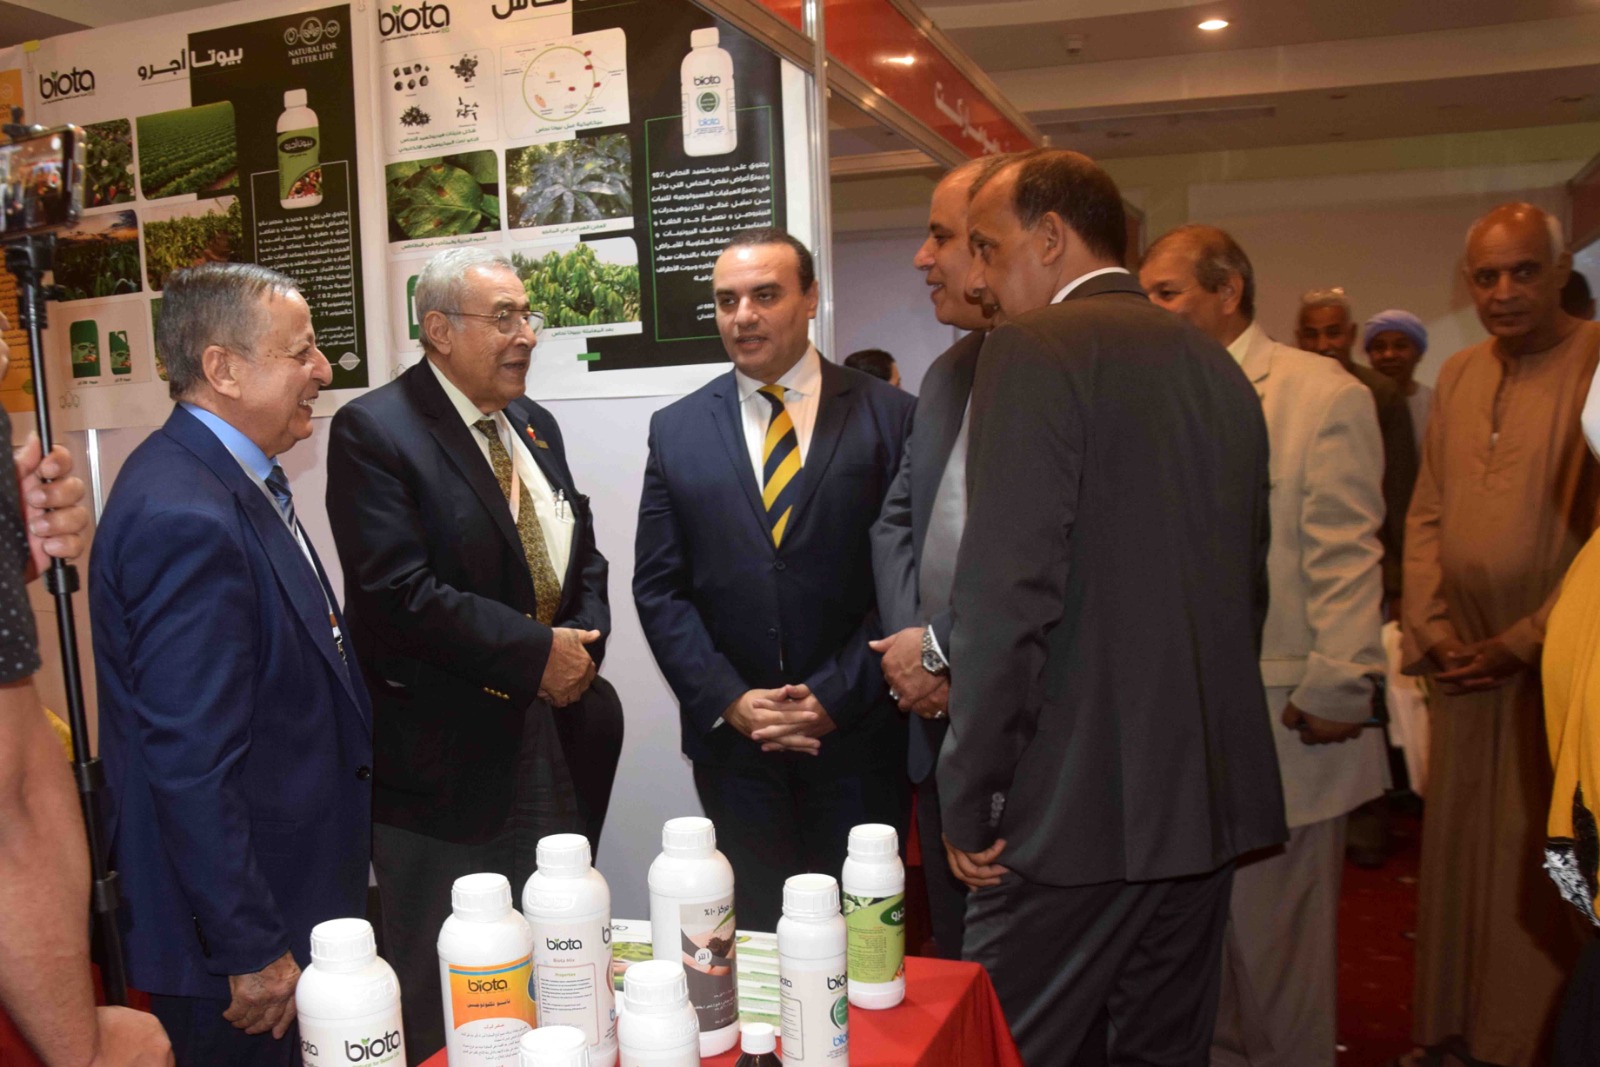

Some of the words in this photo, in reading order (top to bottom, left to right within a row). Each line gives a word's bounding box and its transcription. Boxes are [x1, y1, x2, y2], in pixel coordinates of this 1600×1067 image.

[378, 1, 450, 36] biota
[288, 46, 320, 57] NATURAL
[322, 42, 337, 51] FOR
[191, 48, 243, 68] بيوتا
[292, 54, 318, 65] BETTER
[319, 52, 334, 60] LIFE
[40, 66, 95, 99] biota
[694, 76, 721, 86] biota
[546, 938, 582, 951] biota
[468, 978, 508, 992] biota
[345, 1030, 400, 1062] biota
